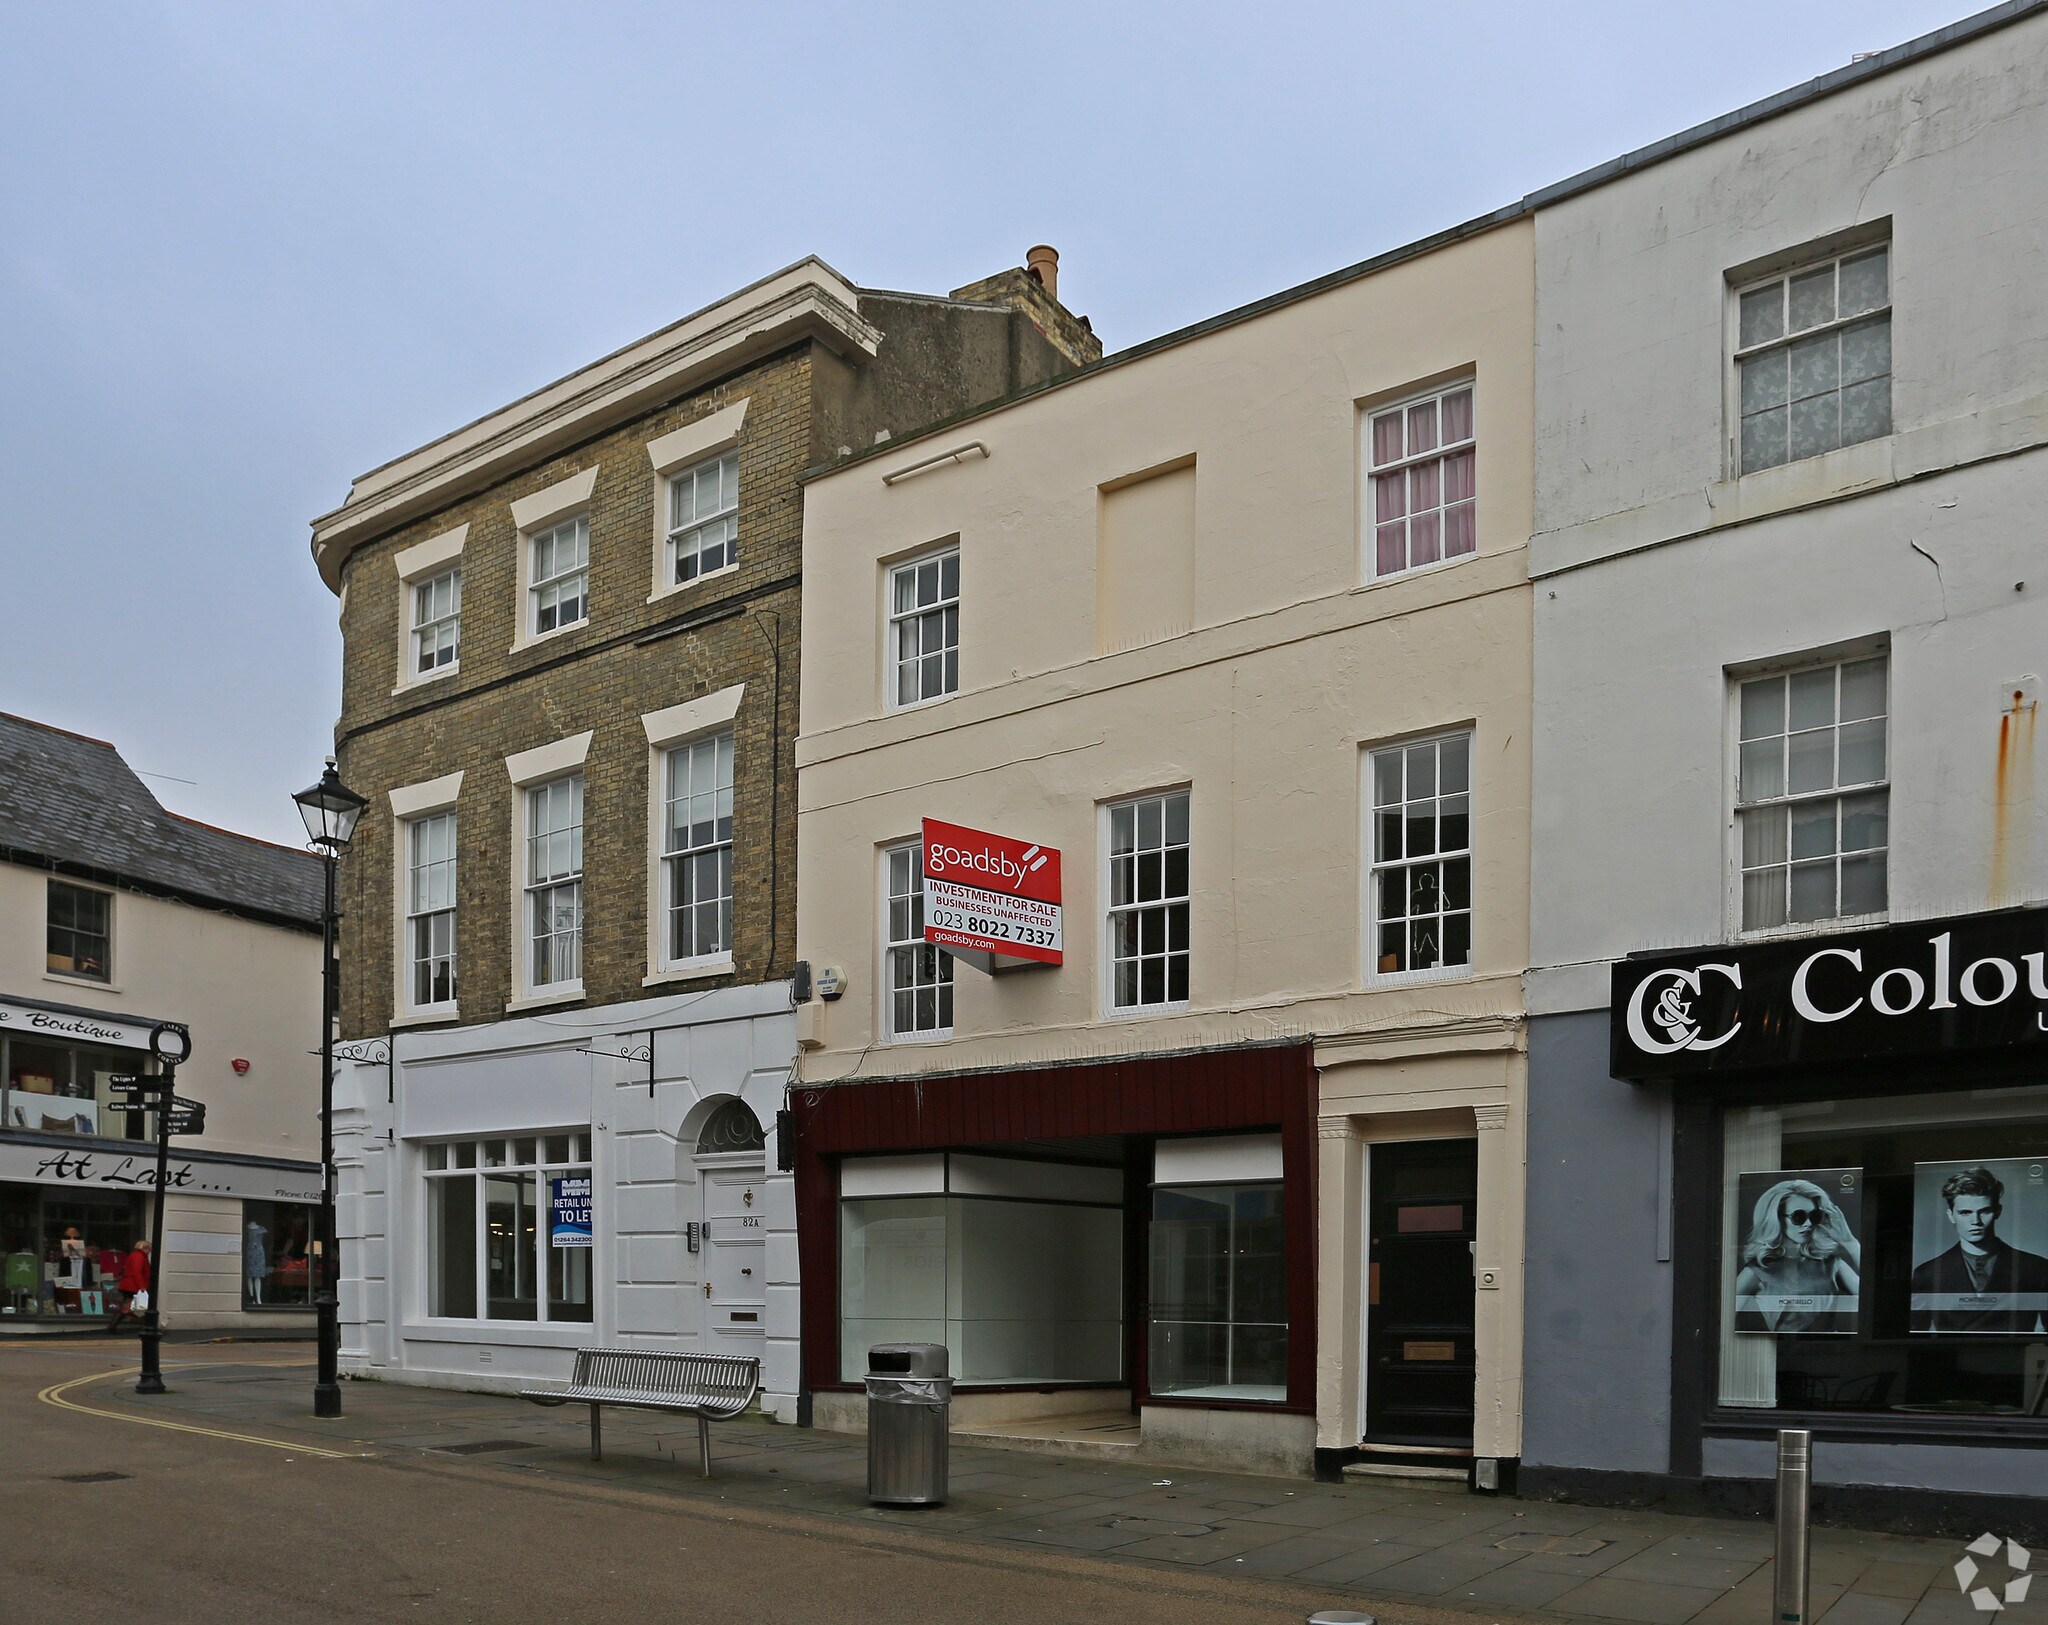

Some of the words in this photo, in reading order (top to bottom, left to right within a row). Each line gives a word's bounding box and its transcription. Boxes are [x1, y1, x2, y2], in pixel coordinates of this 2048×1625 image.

[930, 843, 1028, 889] goadsby
[929, 880, 1003, 906] INVESTMENT
[1006, 897, 1028, 911] FOR
[1030, 903, 1057, 917] SALE
[936, 896, 992, 915] BUSINESSES
[994, 908, 1052, 927] UNAFFECTED
[933, 909, 963, 929] 023
[968, 916, 1010, 939] 8022
[1015, 925, 1055, 947] 7337
[934, 931, 995, 949] goadsby.com
[25, 1012, 124, 1040] Boutique
[35, 1150, 97, 1180] At
[554, 1198, 579, 1208] RETAIL
[560, 1210, 574, 1223] TO
[742, 1217, 759, 1227] 82A
